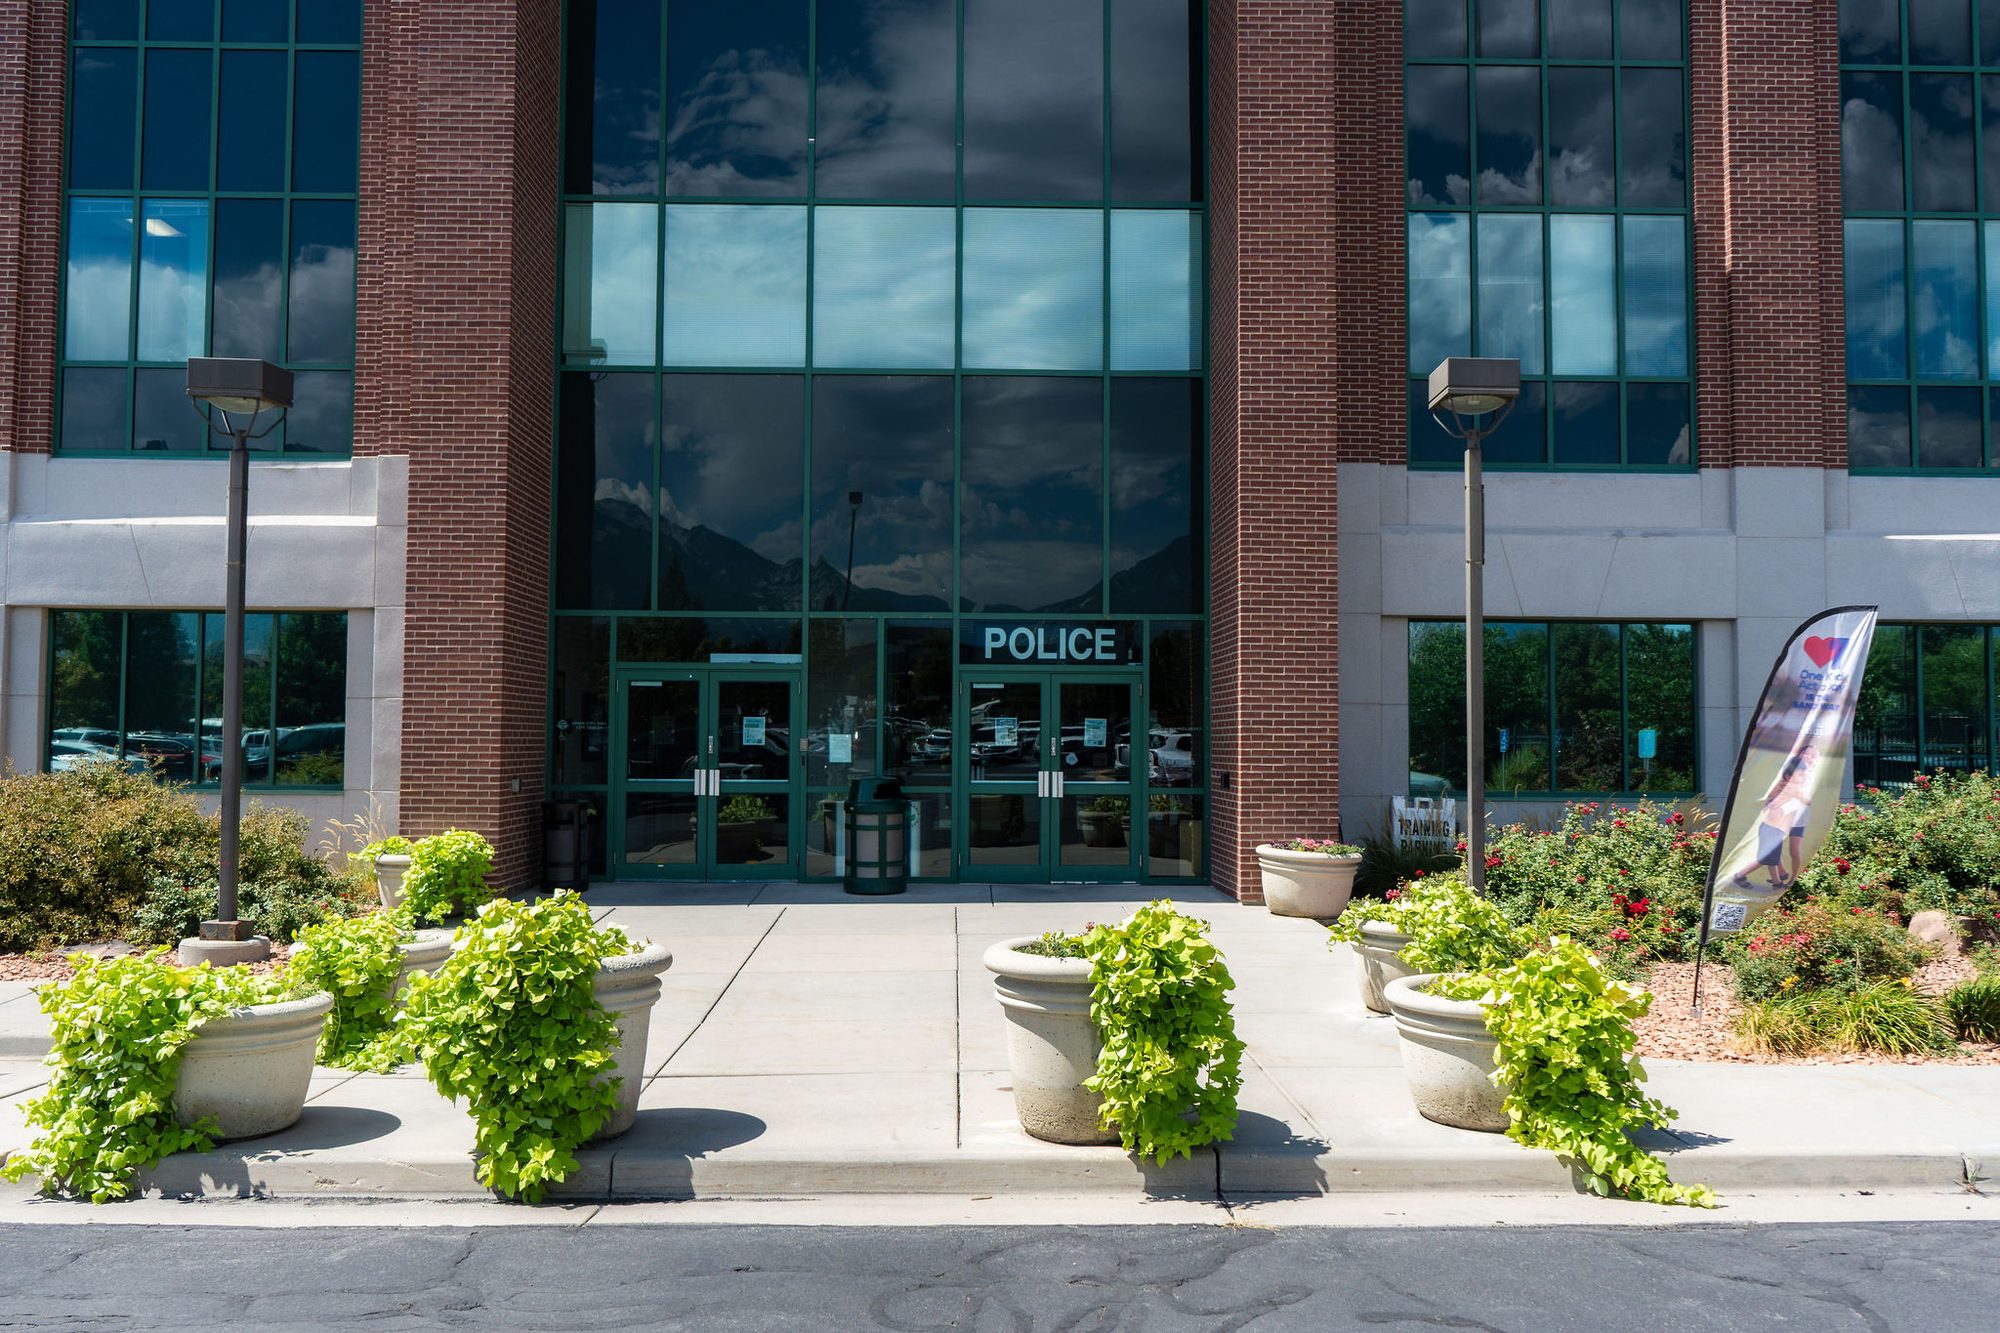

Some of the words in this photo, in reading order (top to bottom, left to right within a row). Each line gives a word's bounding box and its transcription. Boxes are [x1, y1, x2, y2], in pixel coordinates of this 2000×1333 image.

[984, 627, 1116, 660] POLICE
[1800, 669, 1824, 680] One
[1398, 818, 1449, 837] TRAINING
